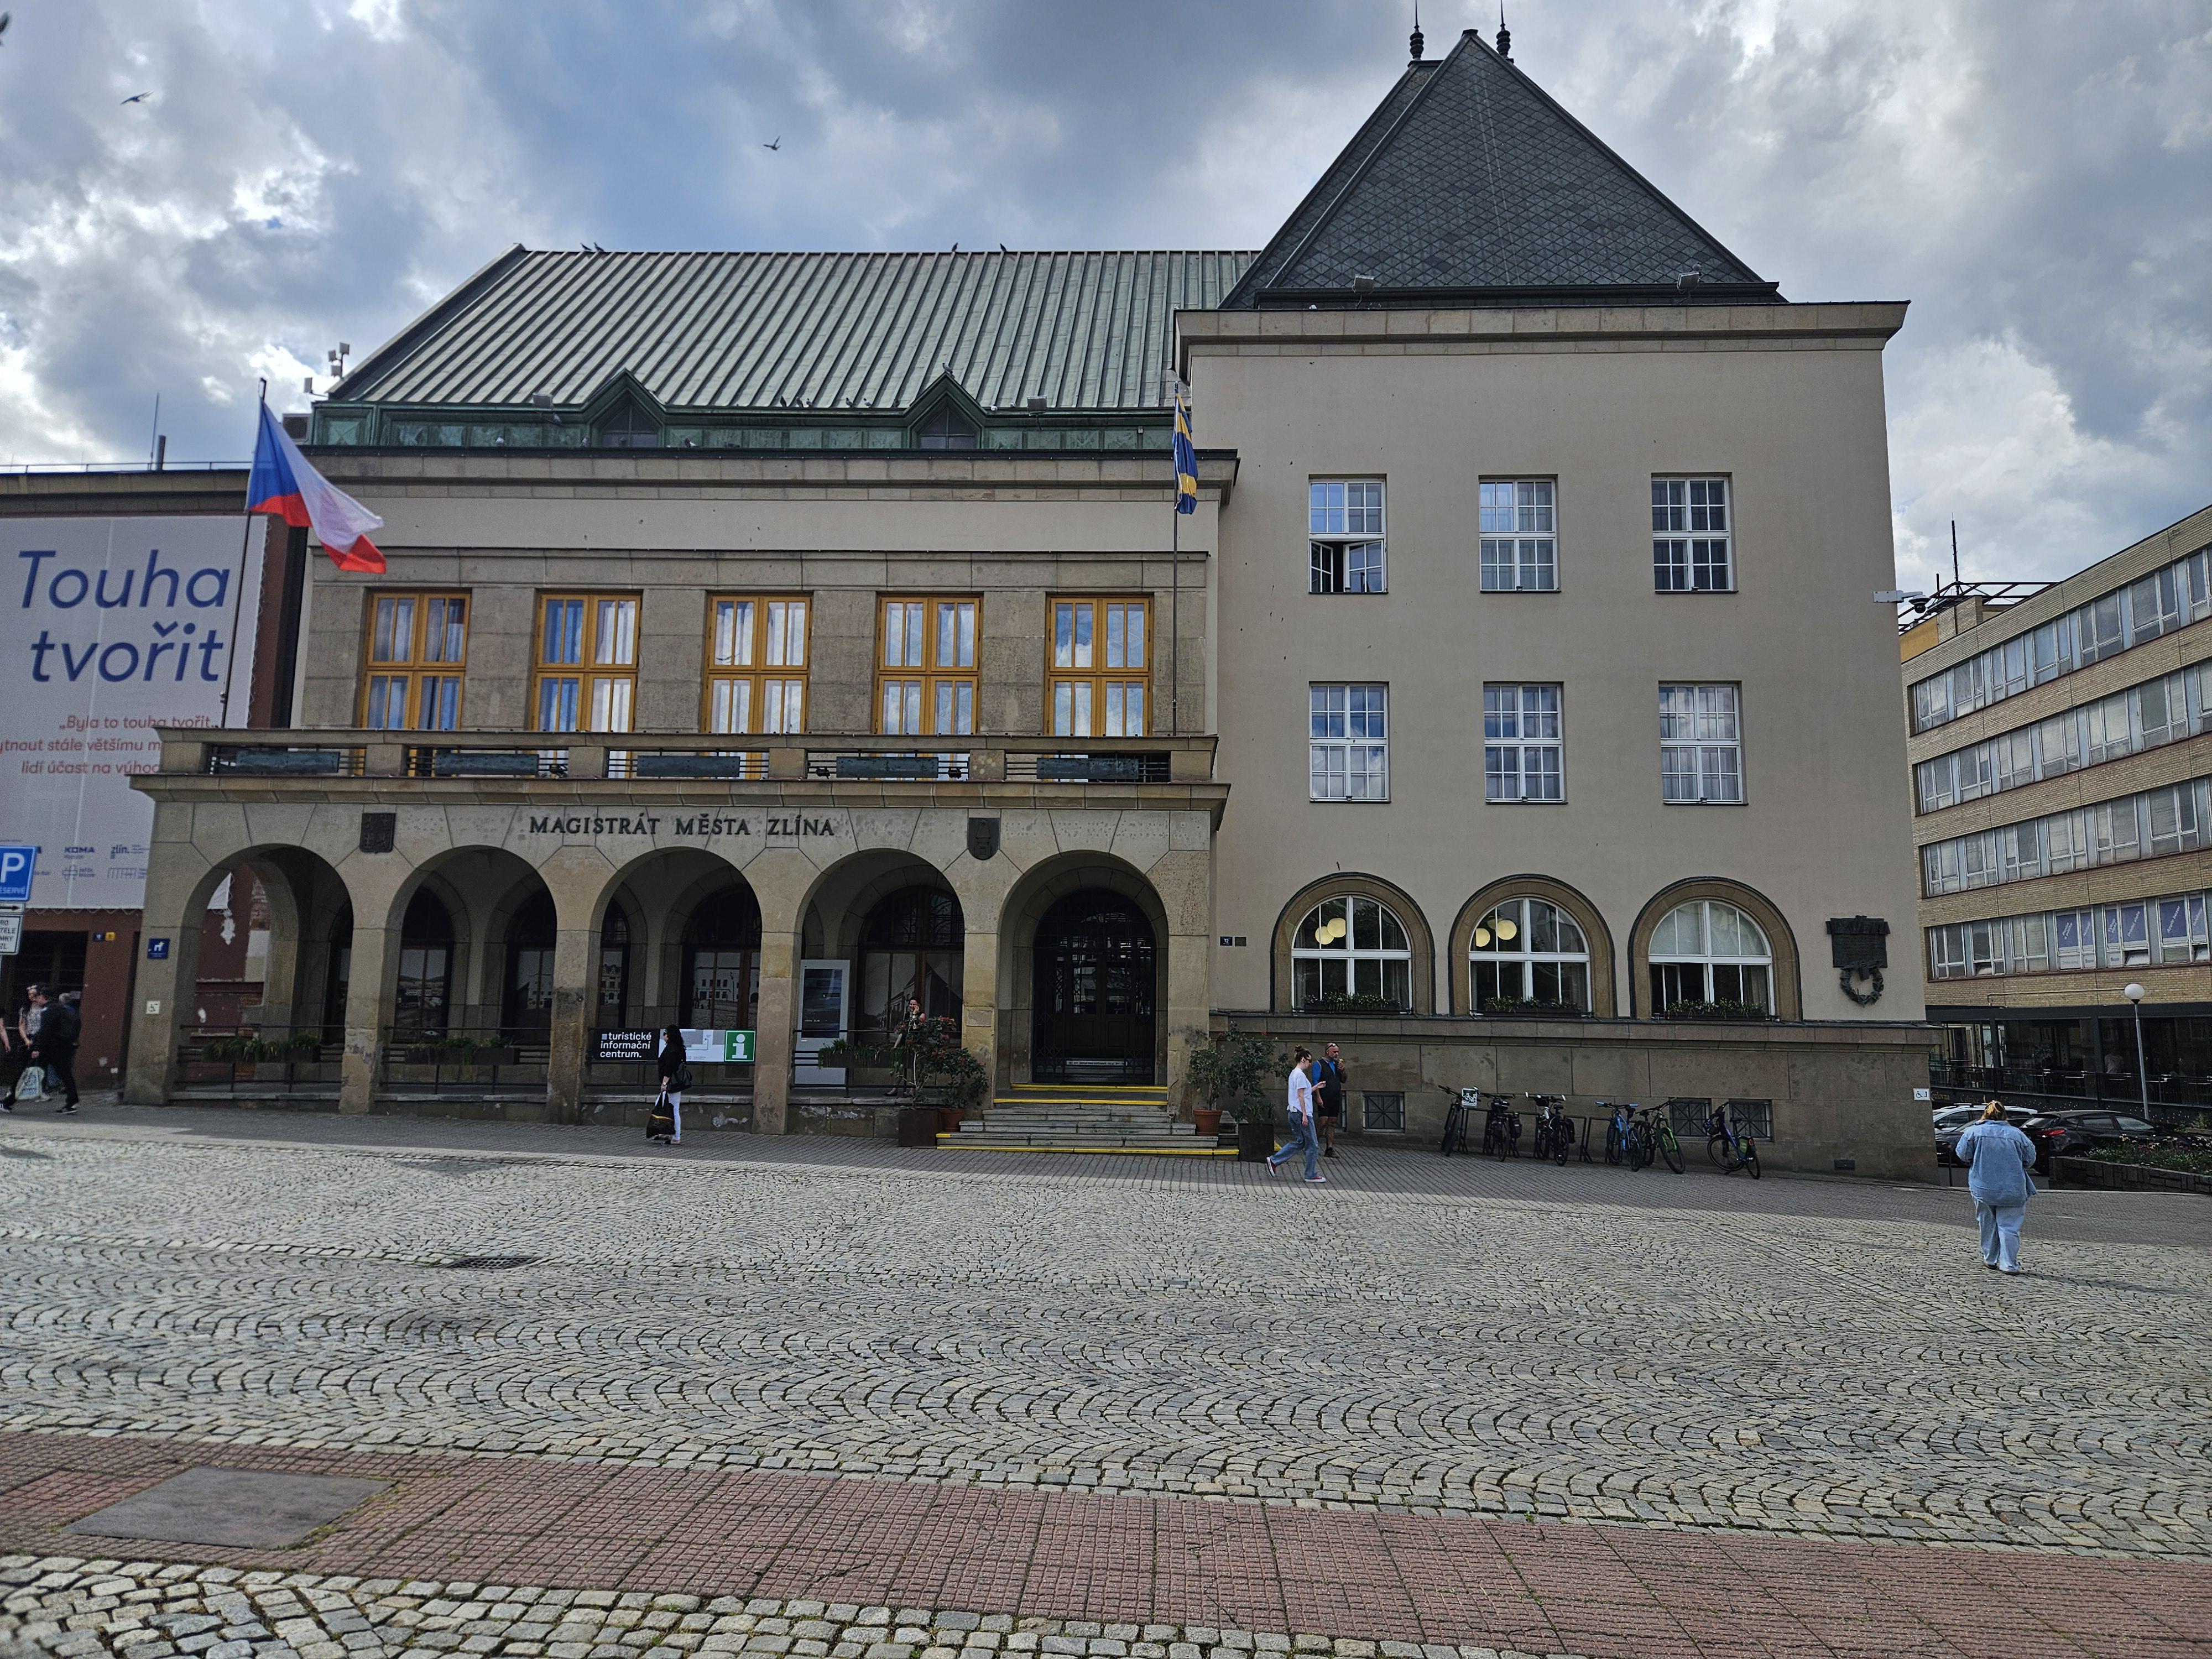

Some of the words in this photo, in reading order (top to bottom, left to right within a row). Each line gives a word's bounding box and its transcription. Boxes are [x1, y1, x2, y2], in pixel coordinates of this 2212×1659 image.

[18, 549, 230, 609] Touha
[30, 620, 223, 682] tvořit
[104, 716, 118, 728] to
[47, 738, 83, 751] stále
[87, 737, 143, 751] většímu
[22, 760, 44, 774] lidí
[48, 760, 88, 774] účast
[92, 764, 111, 774] na
[529, 812, 660, 835] MAGISTRÁT
[675, 813, 750, 836] MĚSTA
[767, 815, 835, 836] ZLÍNA
[1, 852, 25, 883] P
[608, 1031, 652, 1040] turistické
[601, 1040, 651, 1049] informační
[599, 1050, 642, 1058] centrum.
